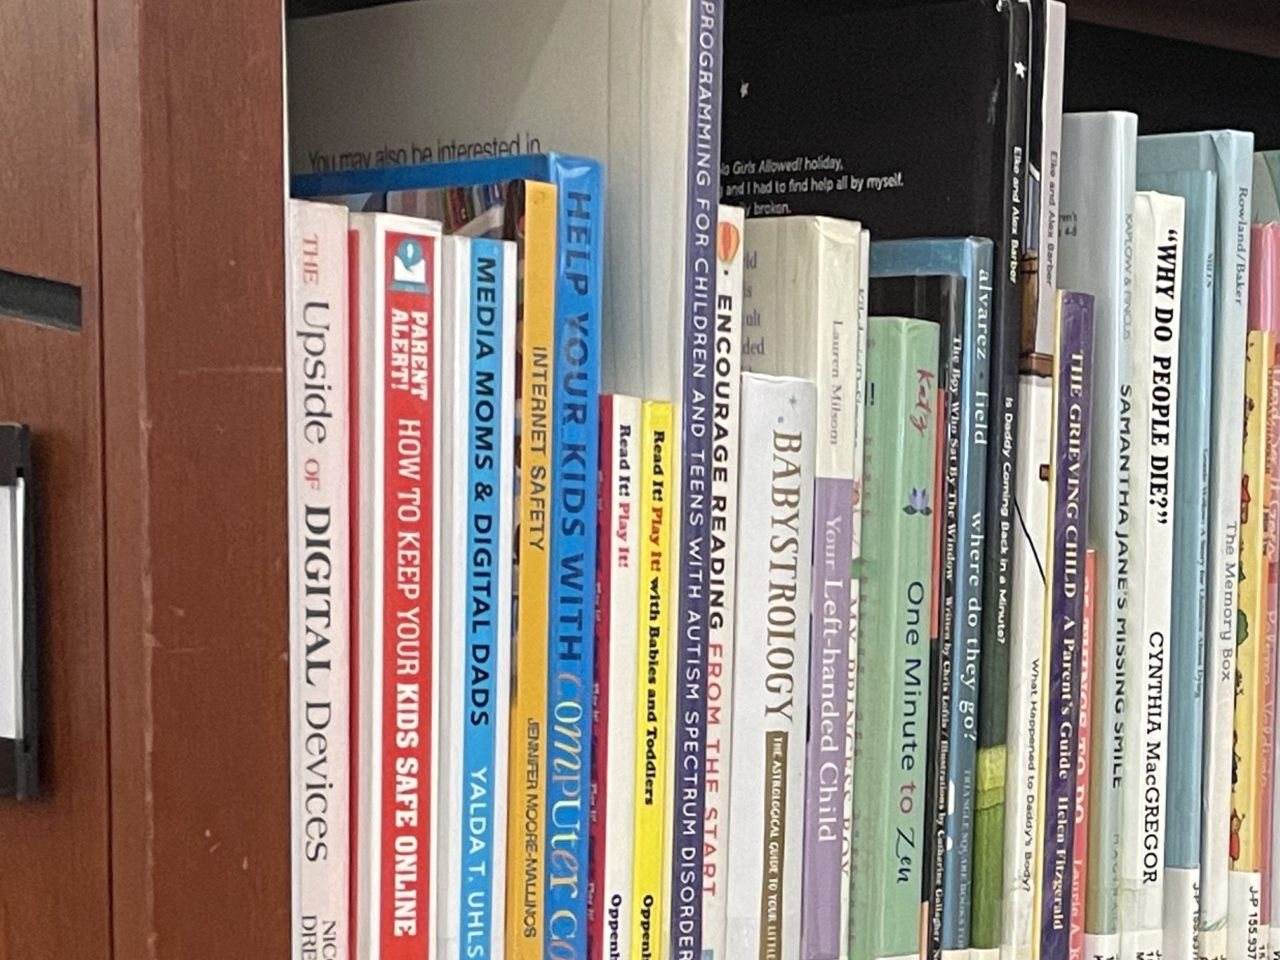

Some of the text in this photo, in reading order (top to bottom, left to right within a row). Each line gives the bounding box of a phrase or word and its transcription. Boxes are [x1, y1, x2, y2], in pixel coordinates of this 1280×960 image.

[376, 131, 541, 164] also be interested in
[693, 3, 714, 186] PROGRAMMING
[693, 198, 711, 249] FOR
[753, 180, 772, 195] had
[775, 181, 786, 194] to
[811, 177, 834, 193] help
[850, 176, 863, 193] by
[867, 172, 904, 191] myself.
[391, 308, 409, 391] ALERT!
[410, 310, 428, 400] PARENT
[691, 257, 710, 379] CHILDREN
[1153, 314, 1173, 341] DO
[691, 390, 707, 438] AND
[1151, 357, 1172, 447] PEOPLE
[471, 257, 495, 726] MEDIA MOMS & DIGITAL DADS
[688, 450, 704, 526] TEENS
[297, 234, 333, 863] THE Upside OF DIGITAL Devices
[548, 191, 592, 900] HELP YOUR KIDS WITH Computer
[687, 540, 703, 599] WITH
[702, 295, 732, 896] ENCOURAGE READING FROM THE START
[763, 429, 803, 726] BABYSTROLOGY
[394, 419, 421, 937] HOW TO KEEP YOUR KIDS SAFE ONLINE
[644, 577, 661, 805] with Babies and Toddlers
[685, 612, 703, 701] AUTISM
[682, 711, 701, 836] SPECTRUM
[896, 580, 925, 885] One Minute to Zen
[1141, 631, 1165, 884] CYNTHIA MacGREGOR
[470, 767, 487, 854] YALDA
